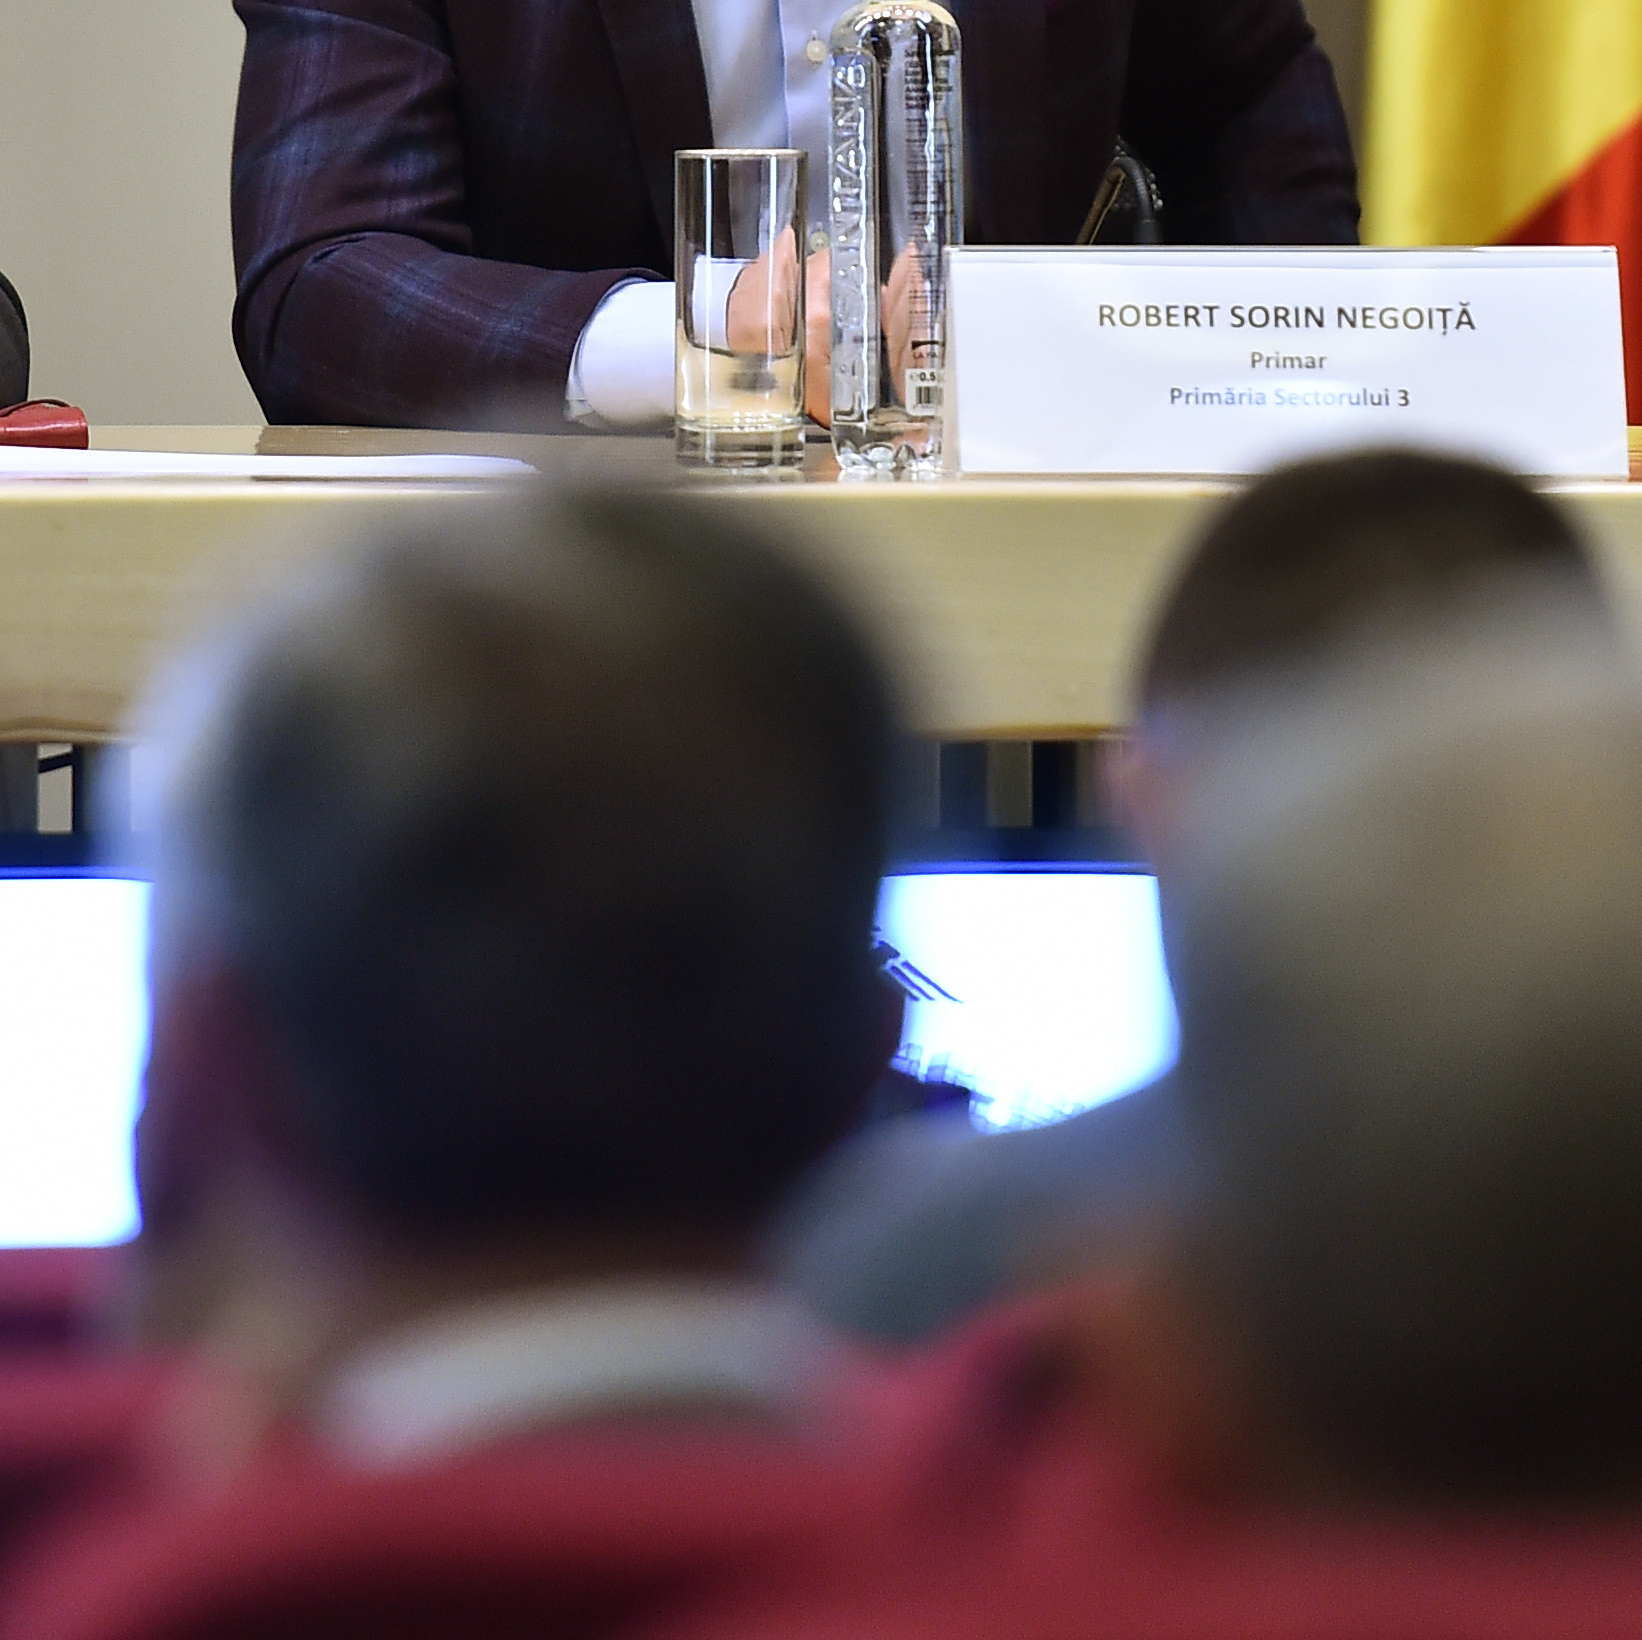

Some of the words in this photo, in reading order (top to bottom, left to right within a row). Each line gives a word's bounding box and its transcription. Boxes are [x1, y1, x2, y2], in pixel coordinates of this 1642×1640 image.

[1098, 304, 1220, 328] ROBERT
[1230, 305, 1325, 329] SORIN
[1337, 301, 1477, 337] NEGOIȚĂ
[1250, 351, 1328, 370] Primar
[1169, 386, 1267, 406] Primăria
[1274, 387, 1390, 407] Sectorului
[1398, 389, 1411, 408] 3
